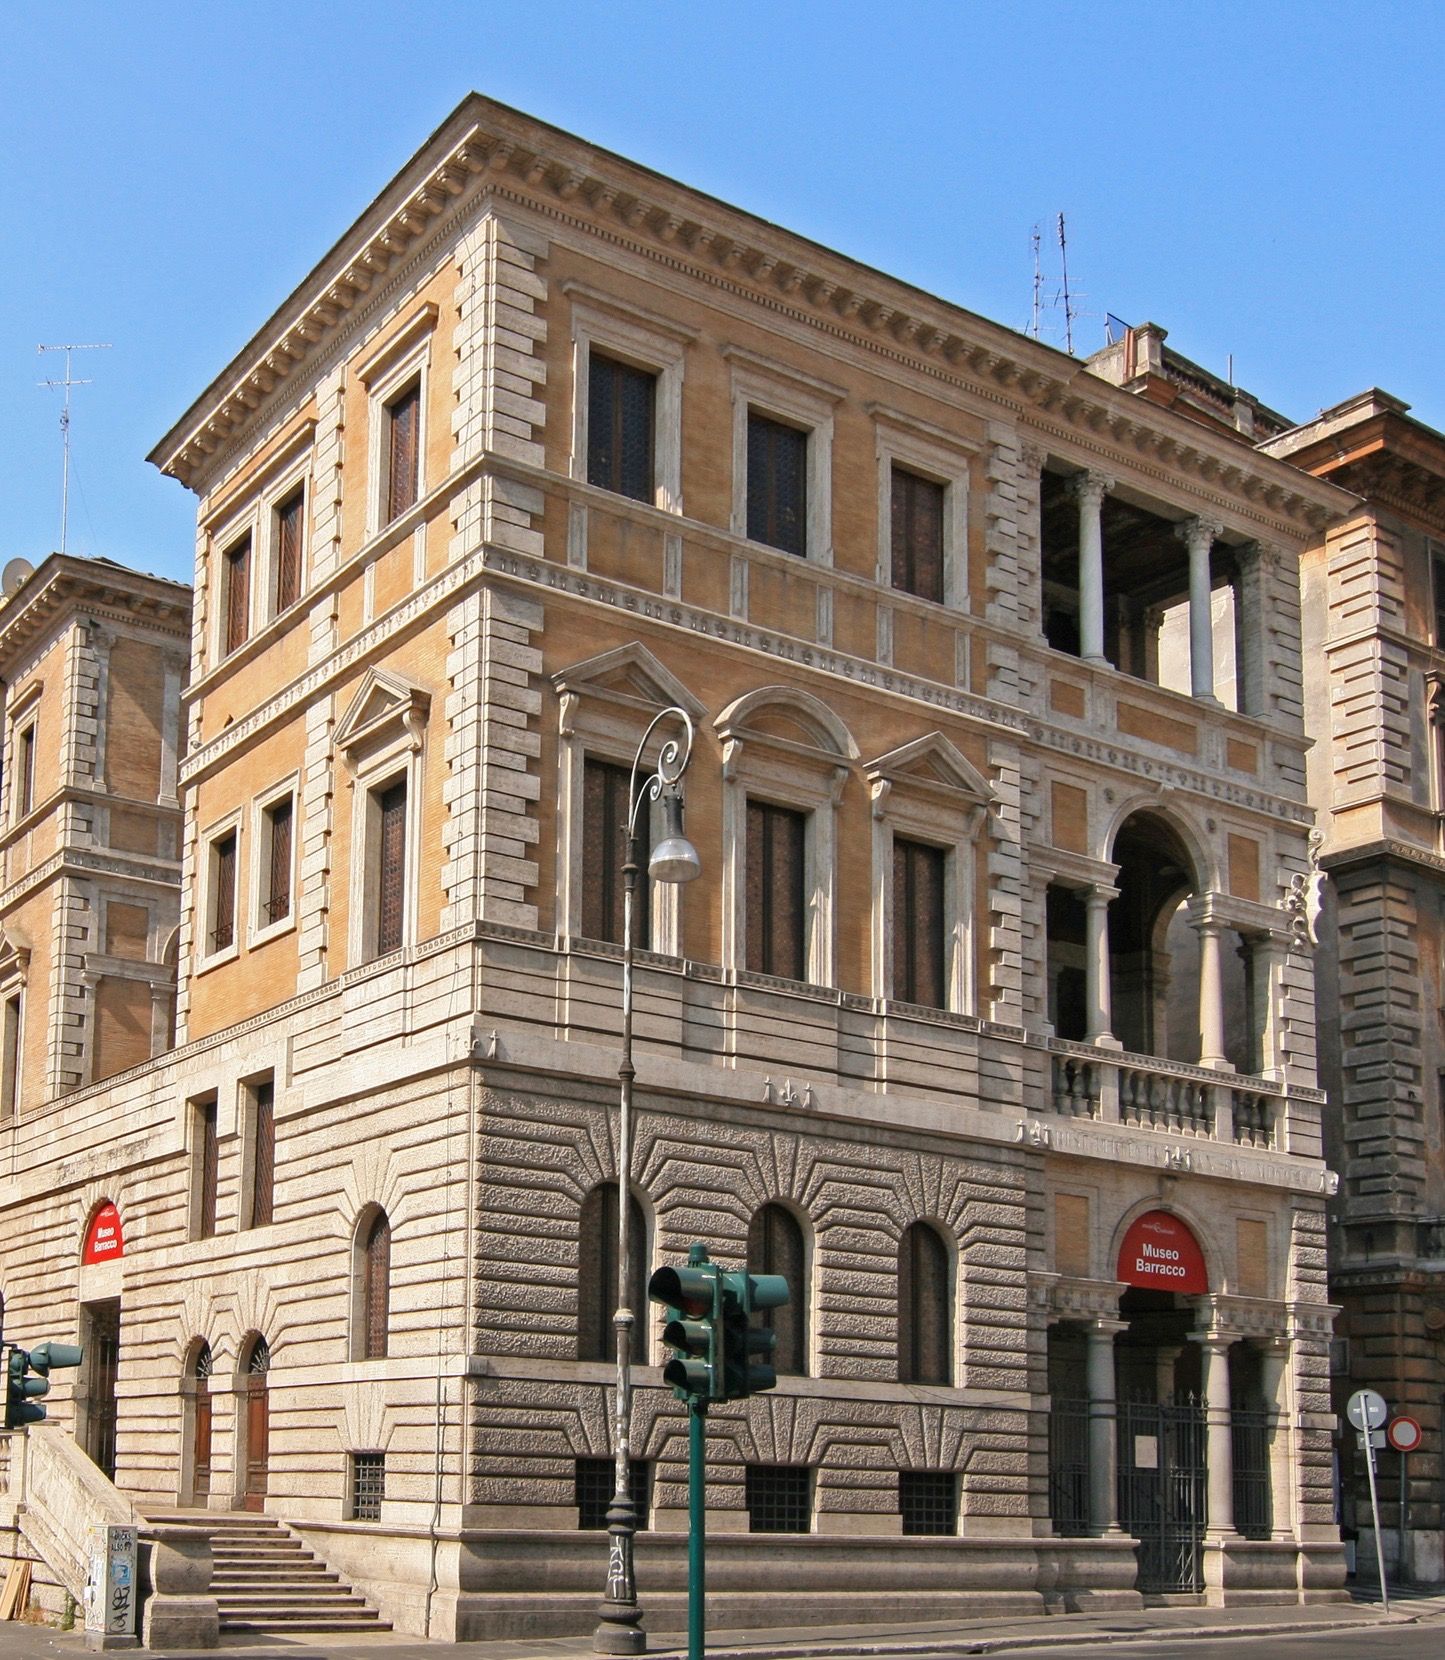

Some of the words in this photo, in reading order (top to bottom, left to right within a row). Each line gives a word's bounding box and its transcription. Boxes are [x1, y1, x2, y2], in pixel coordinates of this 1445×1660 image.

[97, 1227, 115, 1238] Museo
[1142, 1243, 1179, 1260] Museo
[1136, 1258, 1185, 1276] Barracco
